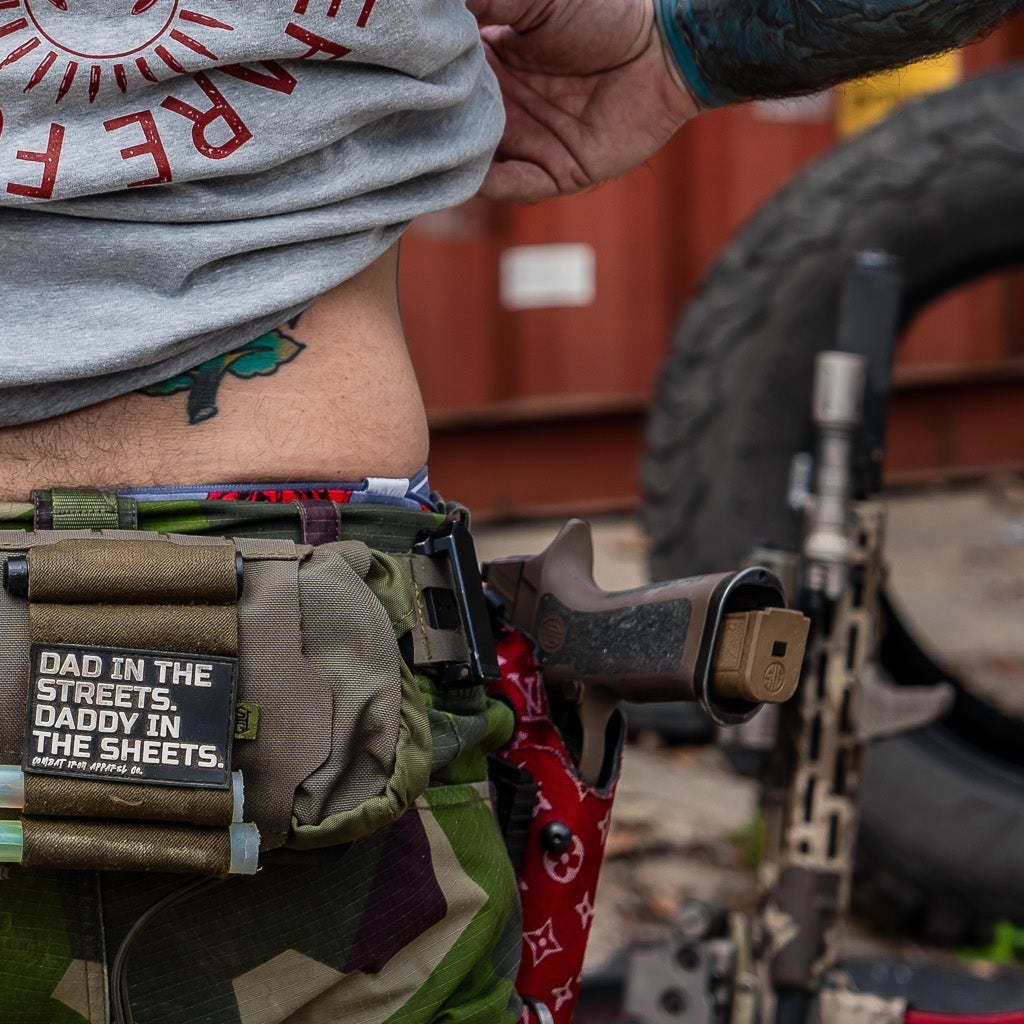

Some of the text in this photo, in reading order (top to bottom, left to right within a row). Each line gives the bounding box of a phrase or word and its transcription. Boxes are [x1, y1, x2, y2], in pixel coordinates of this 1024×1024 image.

[39, 651, 213, 688] DAD IN THE
[36, 678, 178, 712] STREETS.
[34, 704, 181, 739] DADDY IN
[31, 756, 68, 769] COMBAT
[32, 730, 225, 769] THE SHEETS.
